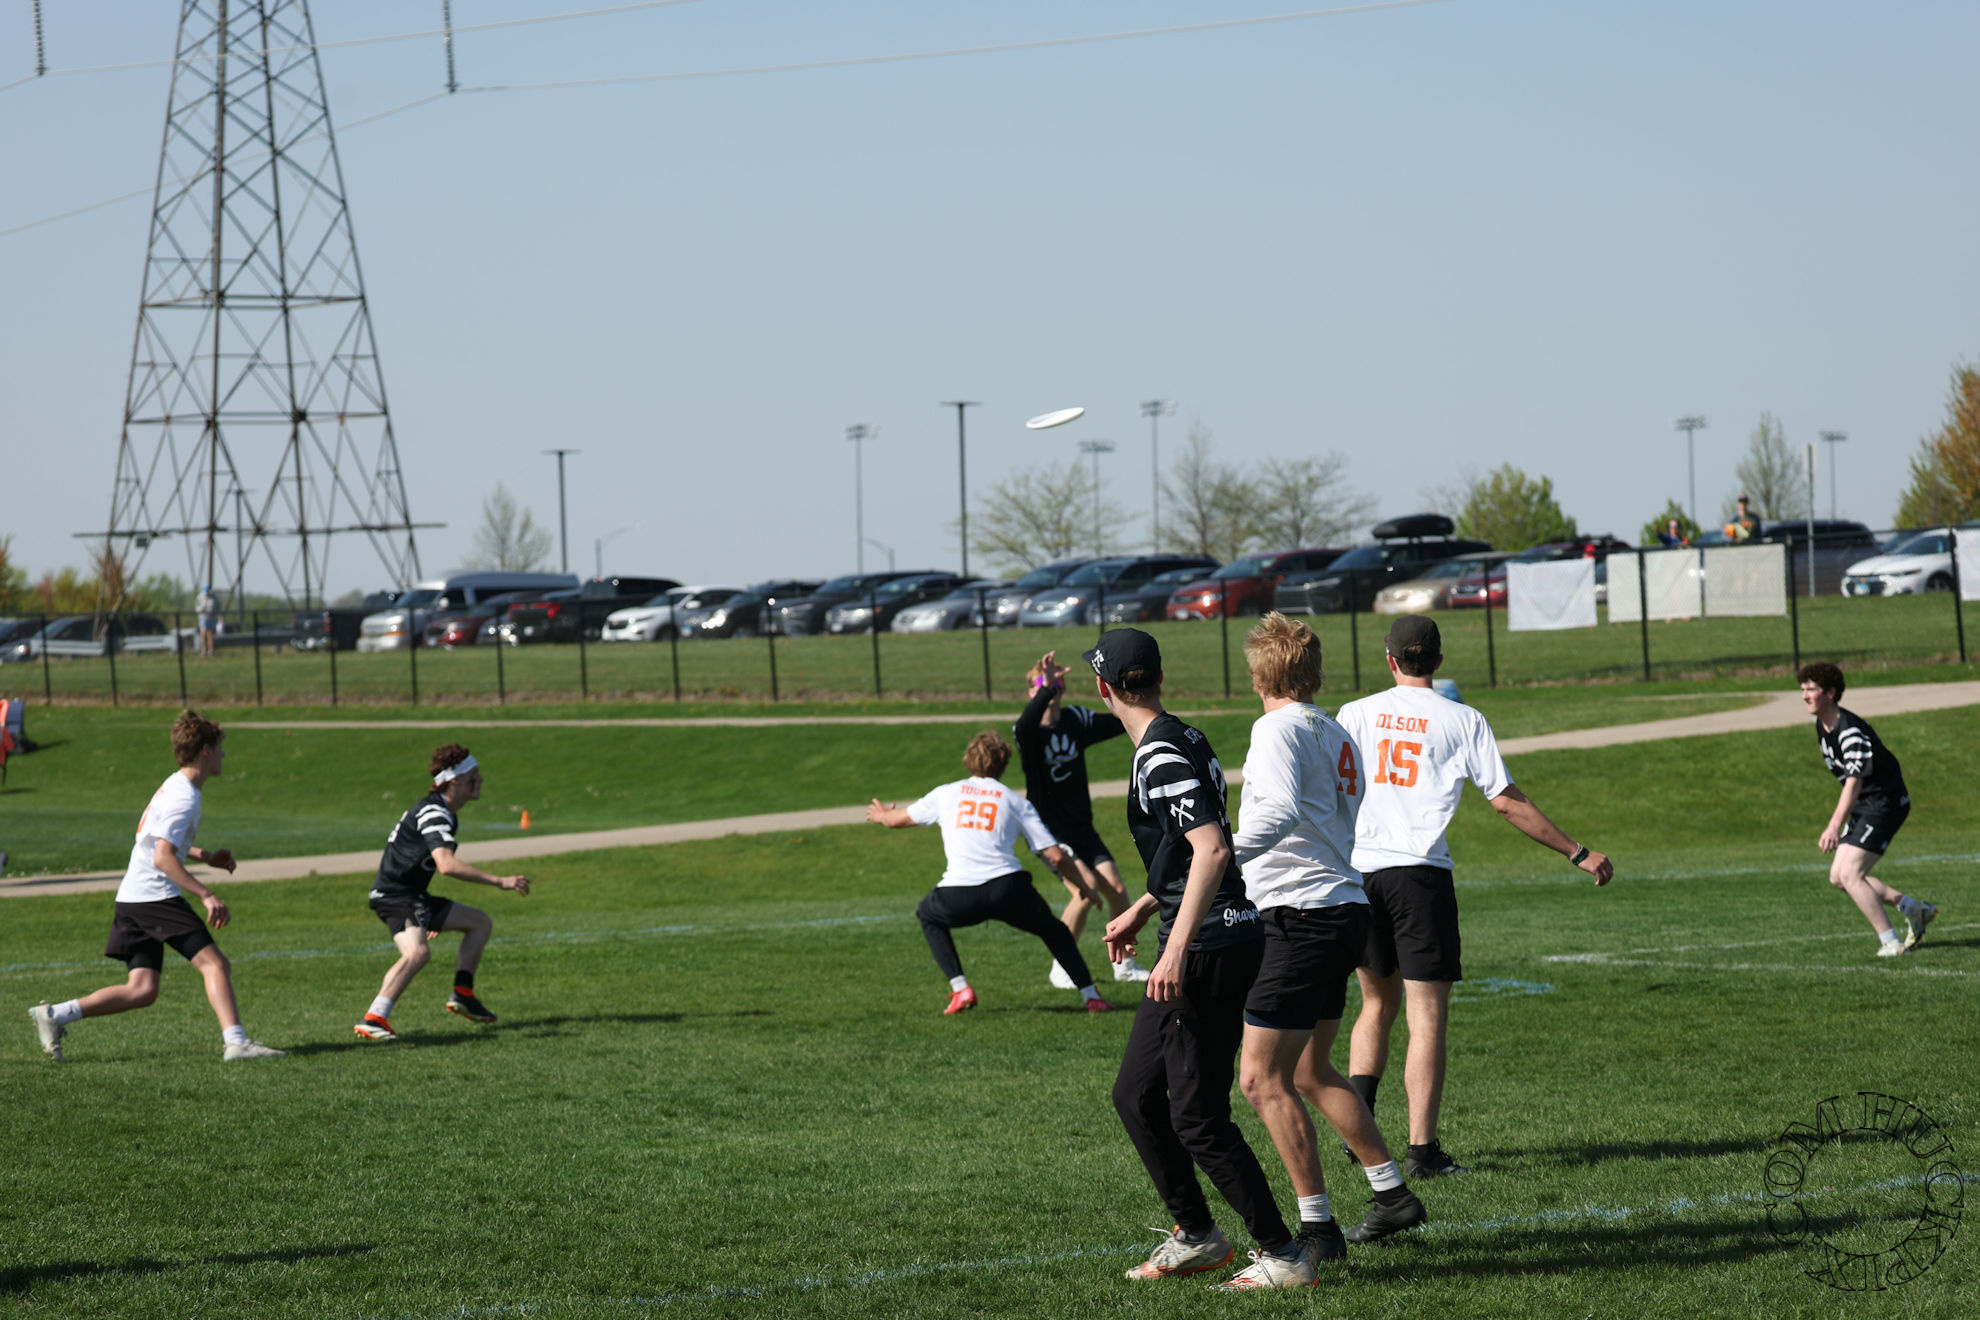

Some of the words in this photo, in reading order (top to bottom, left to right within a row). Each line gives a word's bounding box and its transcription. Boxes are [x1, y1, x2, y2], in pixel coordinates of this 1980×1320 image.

[1375, 713, 1429, 734] OLSON
[1373, 738, 1423, 788] 15
[956, 800, 998, 832] 29
